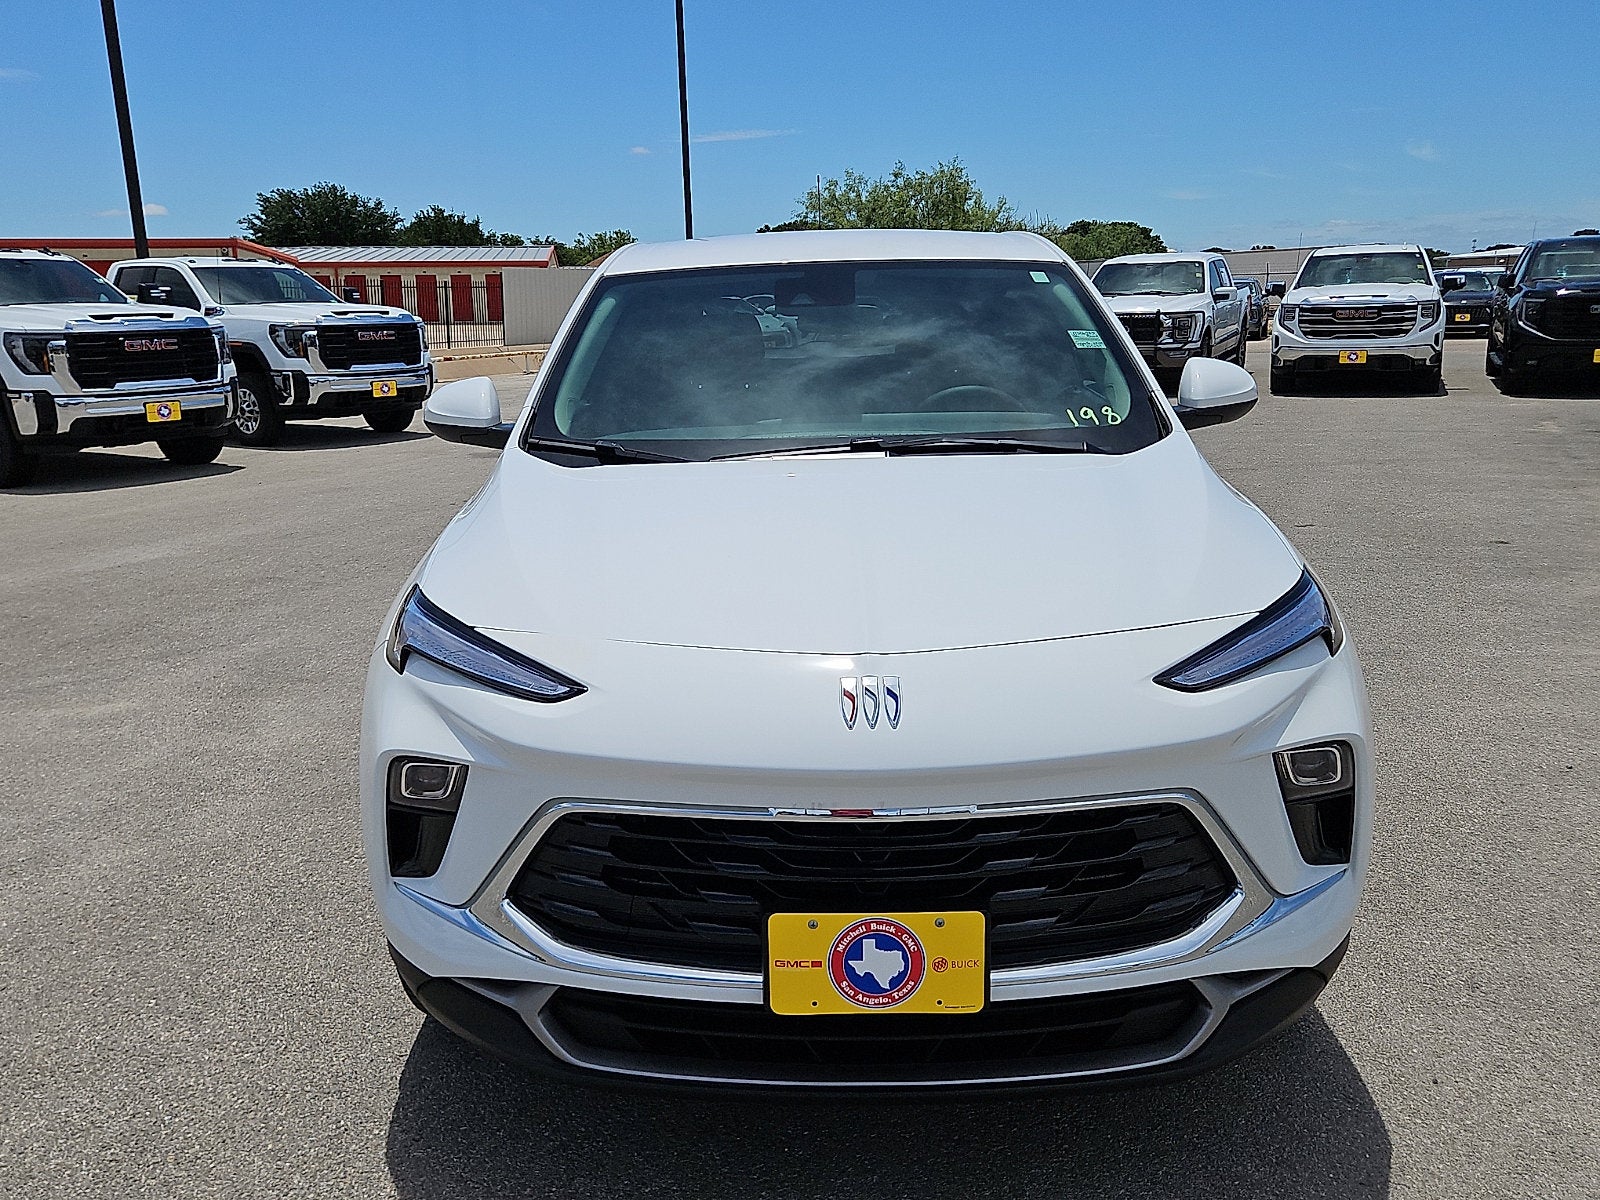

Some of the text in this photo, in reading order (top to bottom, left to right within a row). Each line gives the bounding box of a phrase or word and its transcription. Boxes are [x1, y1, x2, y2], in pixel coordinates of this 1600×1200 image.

[1335, 309, 1378, 318] GMC
[357, 330, 396, 341] GMC
[124, 338, 179, 352] GMC
[1066, 405, 1122, 428] 198
[836, 925, 867, 953] Mitchell
[870, 923, 896, 934] Buick
[902, 933, 918, 953] GMC
[774, 960, 810, 968] GMC
[951, 959, 980, 969] BUICK
[840, 980, 915, 1005] San Angelo, Texas
